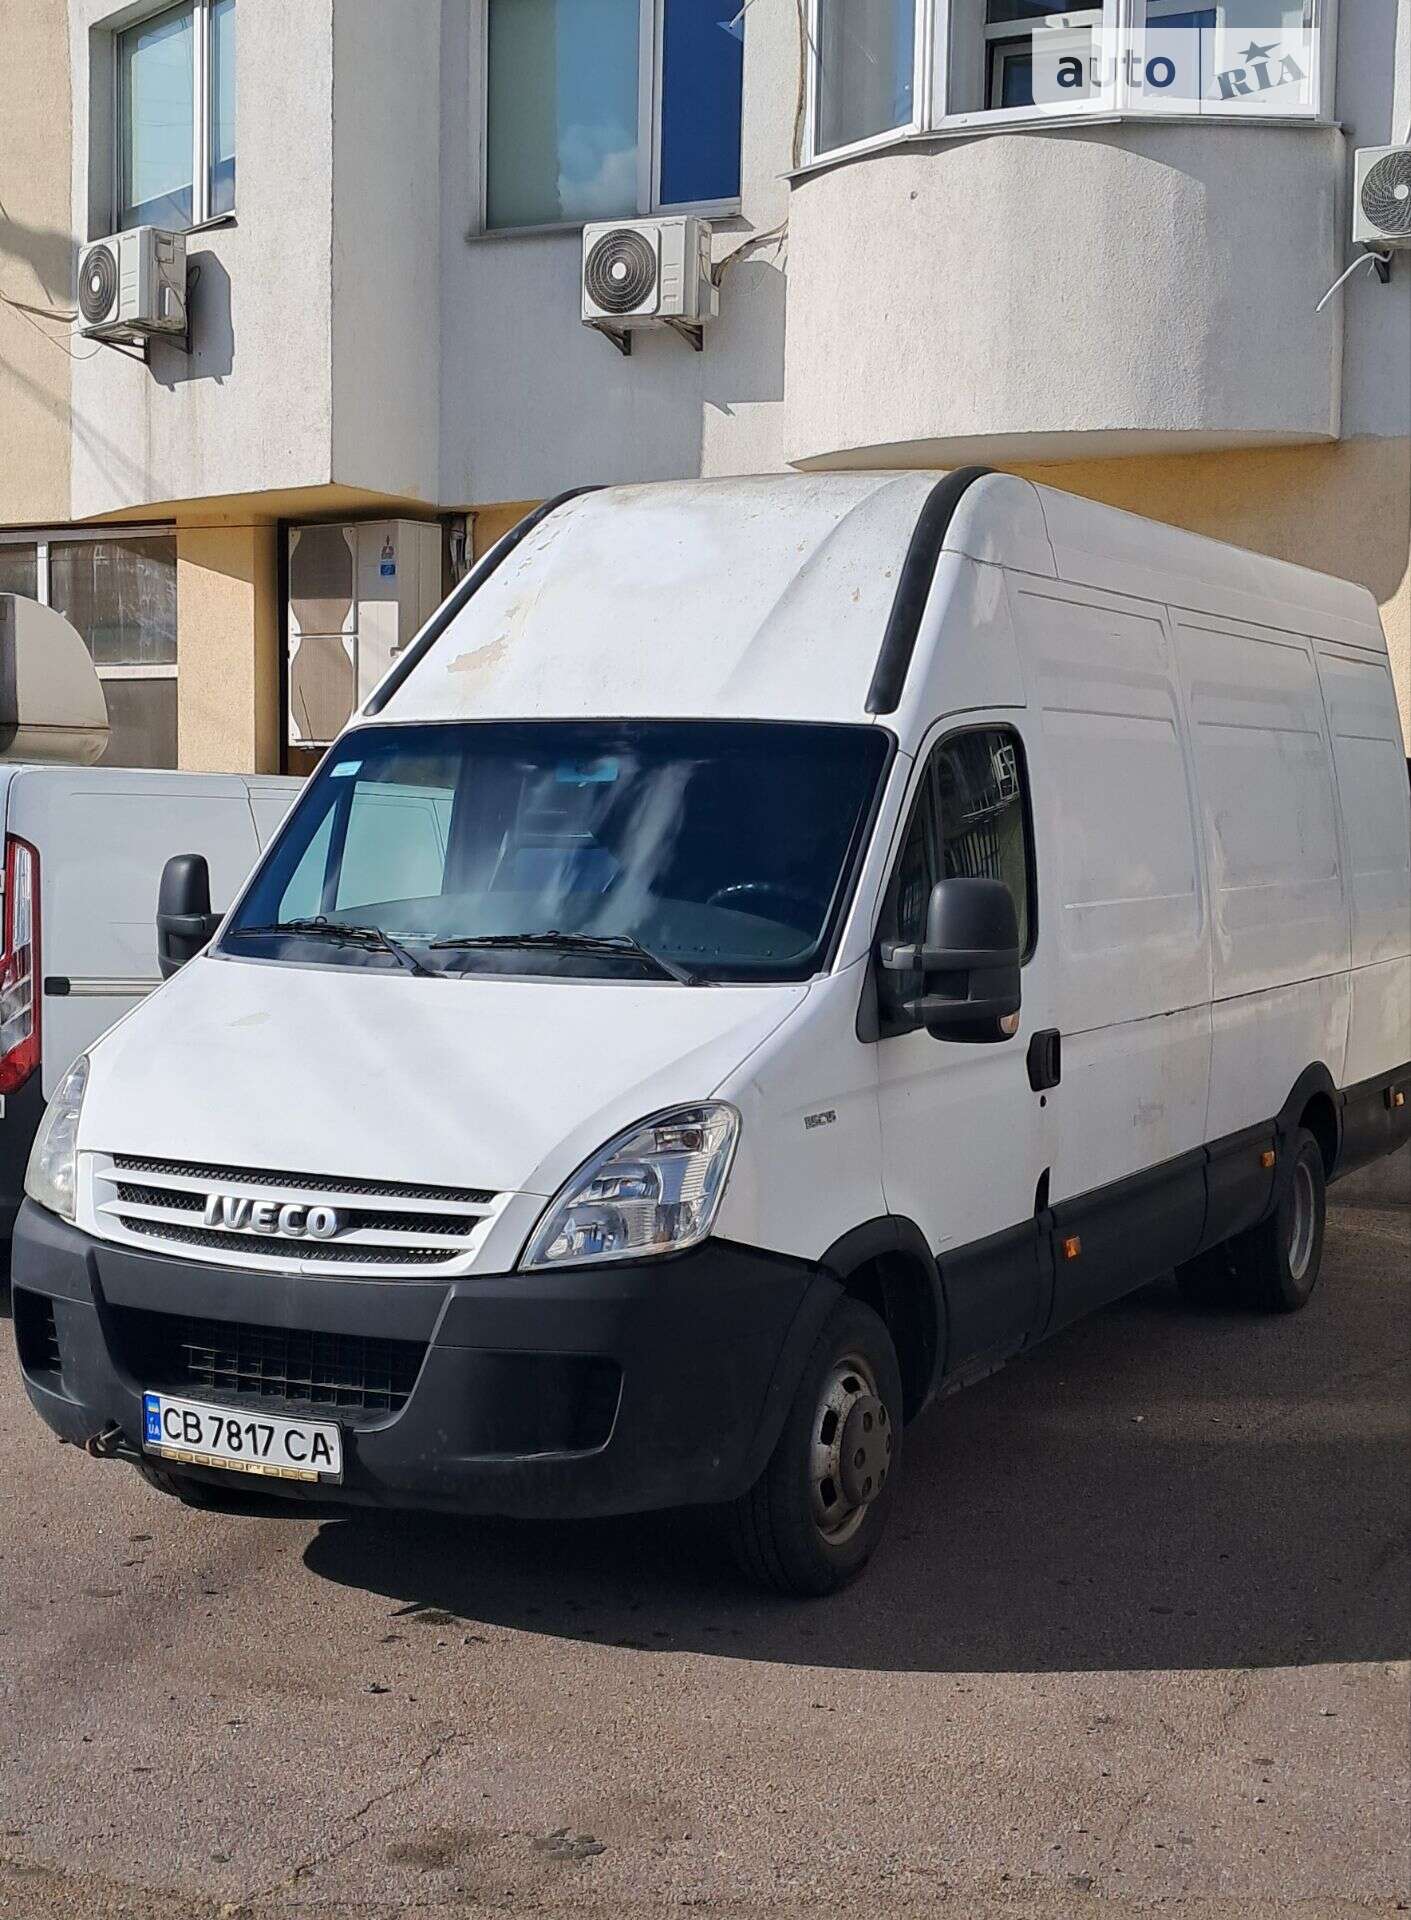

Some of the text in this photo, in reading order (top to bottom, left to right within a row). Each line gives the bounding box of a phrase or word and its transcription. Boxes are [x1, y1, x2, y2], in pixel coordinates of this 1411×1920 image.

[204, 1194, 337, 1239] IVECO
[163, 1407, 332, 1465] CB 7817 CA
